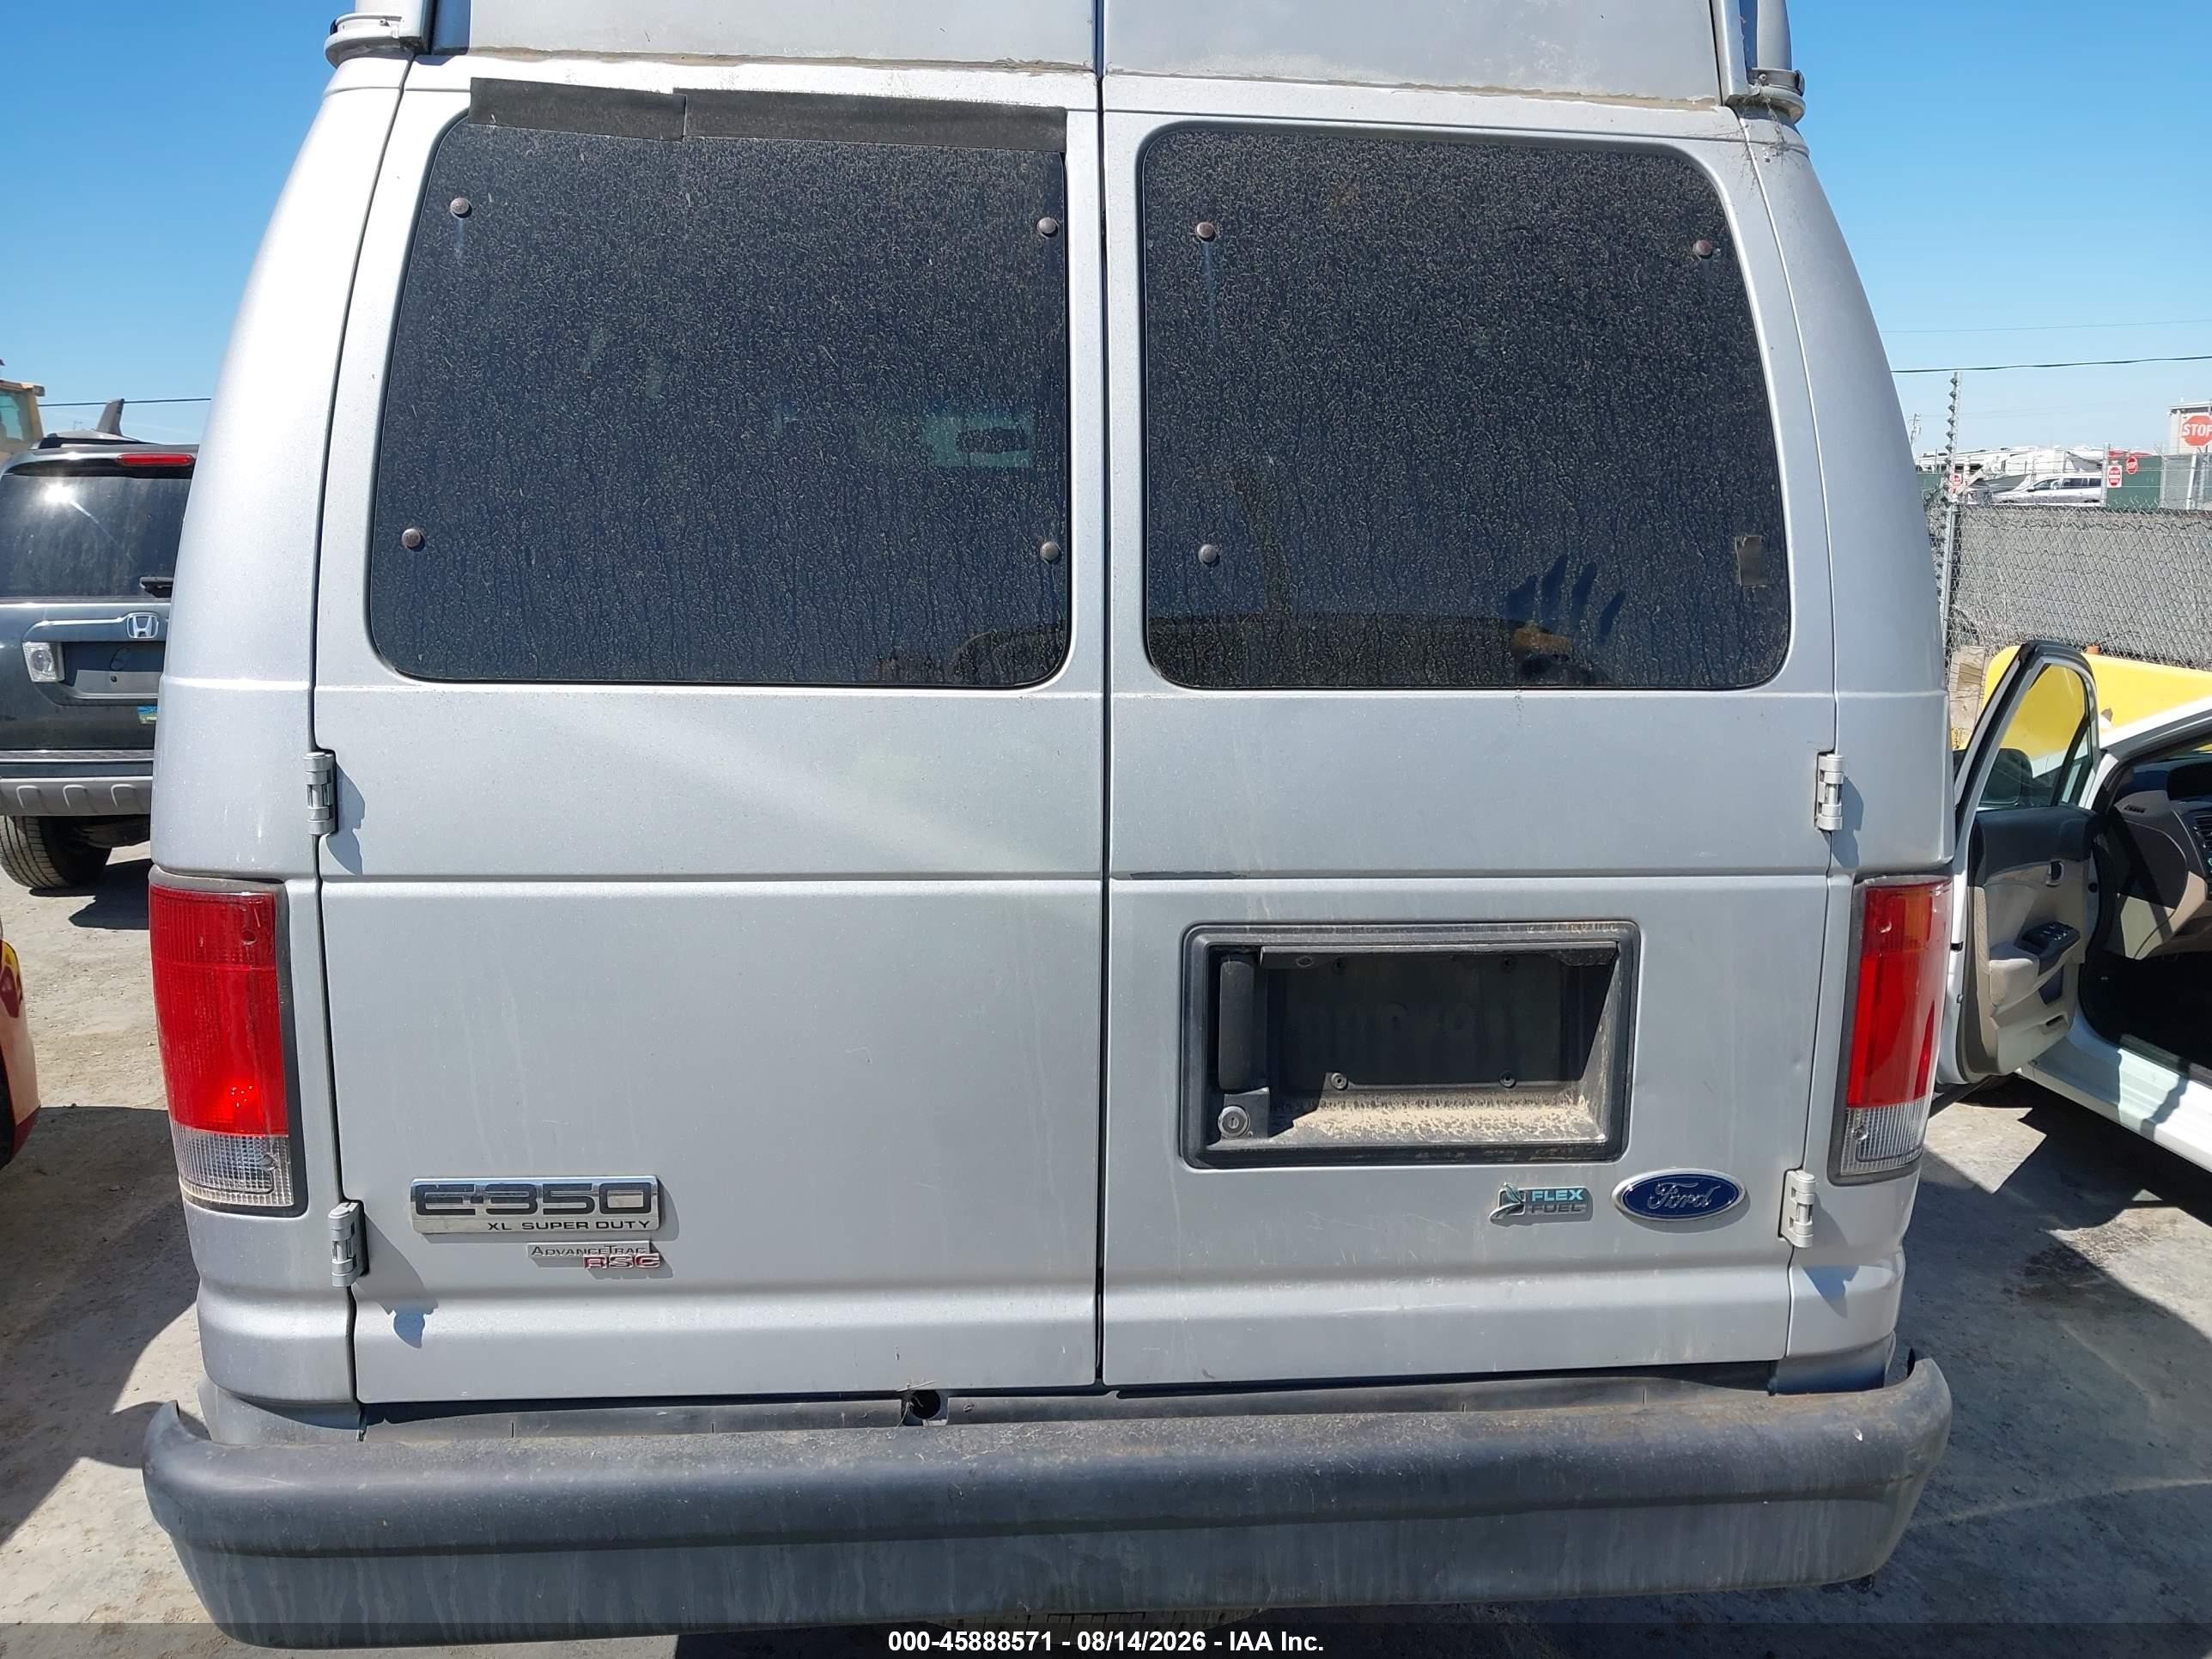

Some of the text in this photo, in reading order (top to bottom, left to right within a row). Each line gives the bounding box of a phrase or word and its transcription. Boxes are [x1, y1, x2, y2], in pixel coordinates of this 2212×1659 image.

[415, 1182, 652, 1216] E-350
[1531, 1189, 1583, 1202] FLEX
[1647, 1182, 1721, 1210] Ford
[1530, 1203, 1586, 1213] FUEL
[487, 1220, 651, 1231] XL SUPER DUTY
[583, 1253, 660, 1269] RSC
